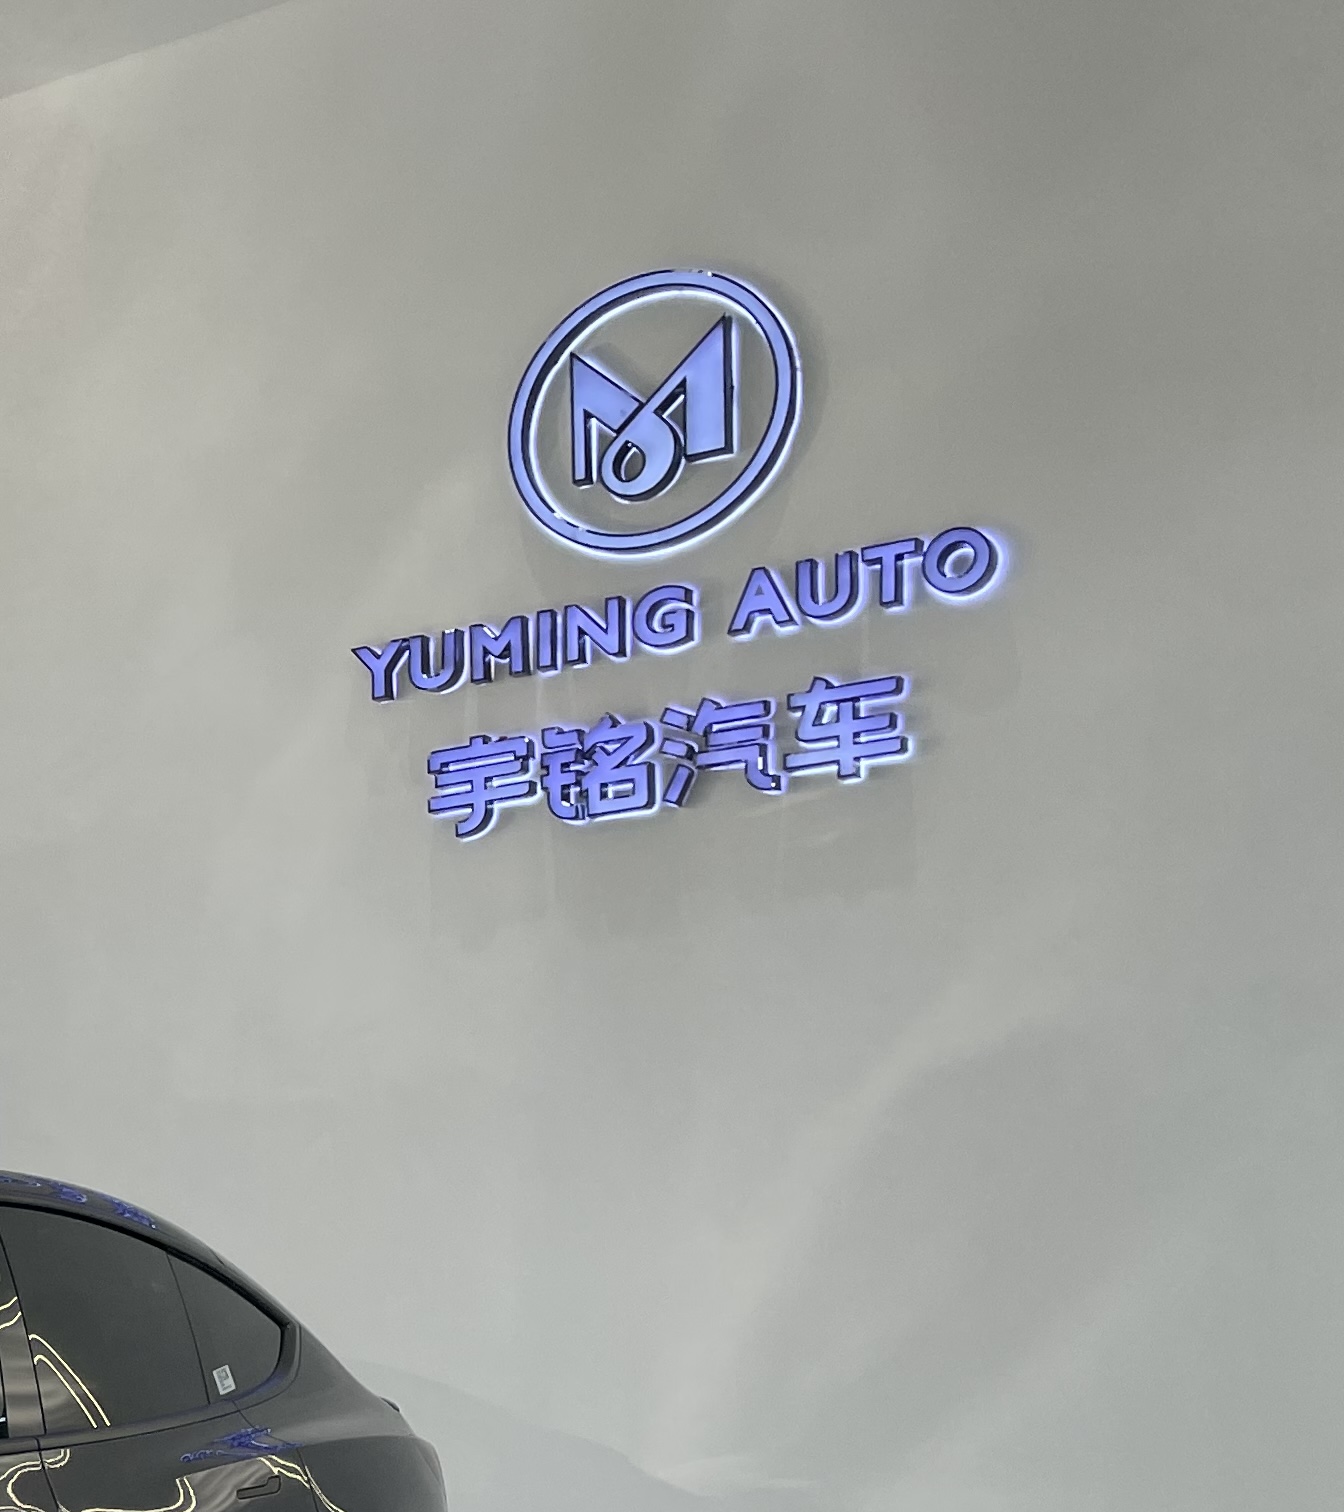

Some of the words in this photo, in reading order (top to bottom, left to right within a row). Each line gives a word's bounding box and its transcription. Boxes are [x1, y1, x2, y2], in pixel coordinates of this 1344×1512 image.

[351, 585, 695, 703] YUMING
[728, 527, 1003, 641] AUTO
[427, 676, 909, 841] 宇铭汽车
